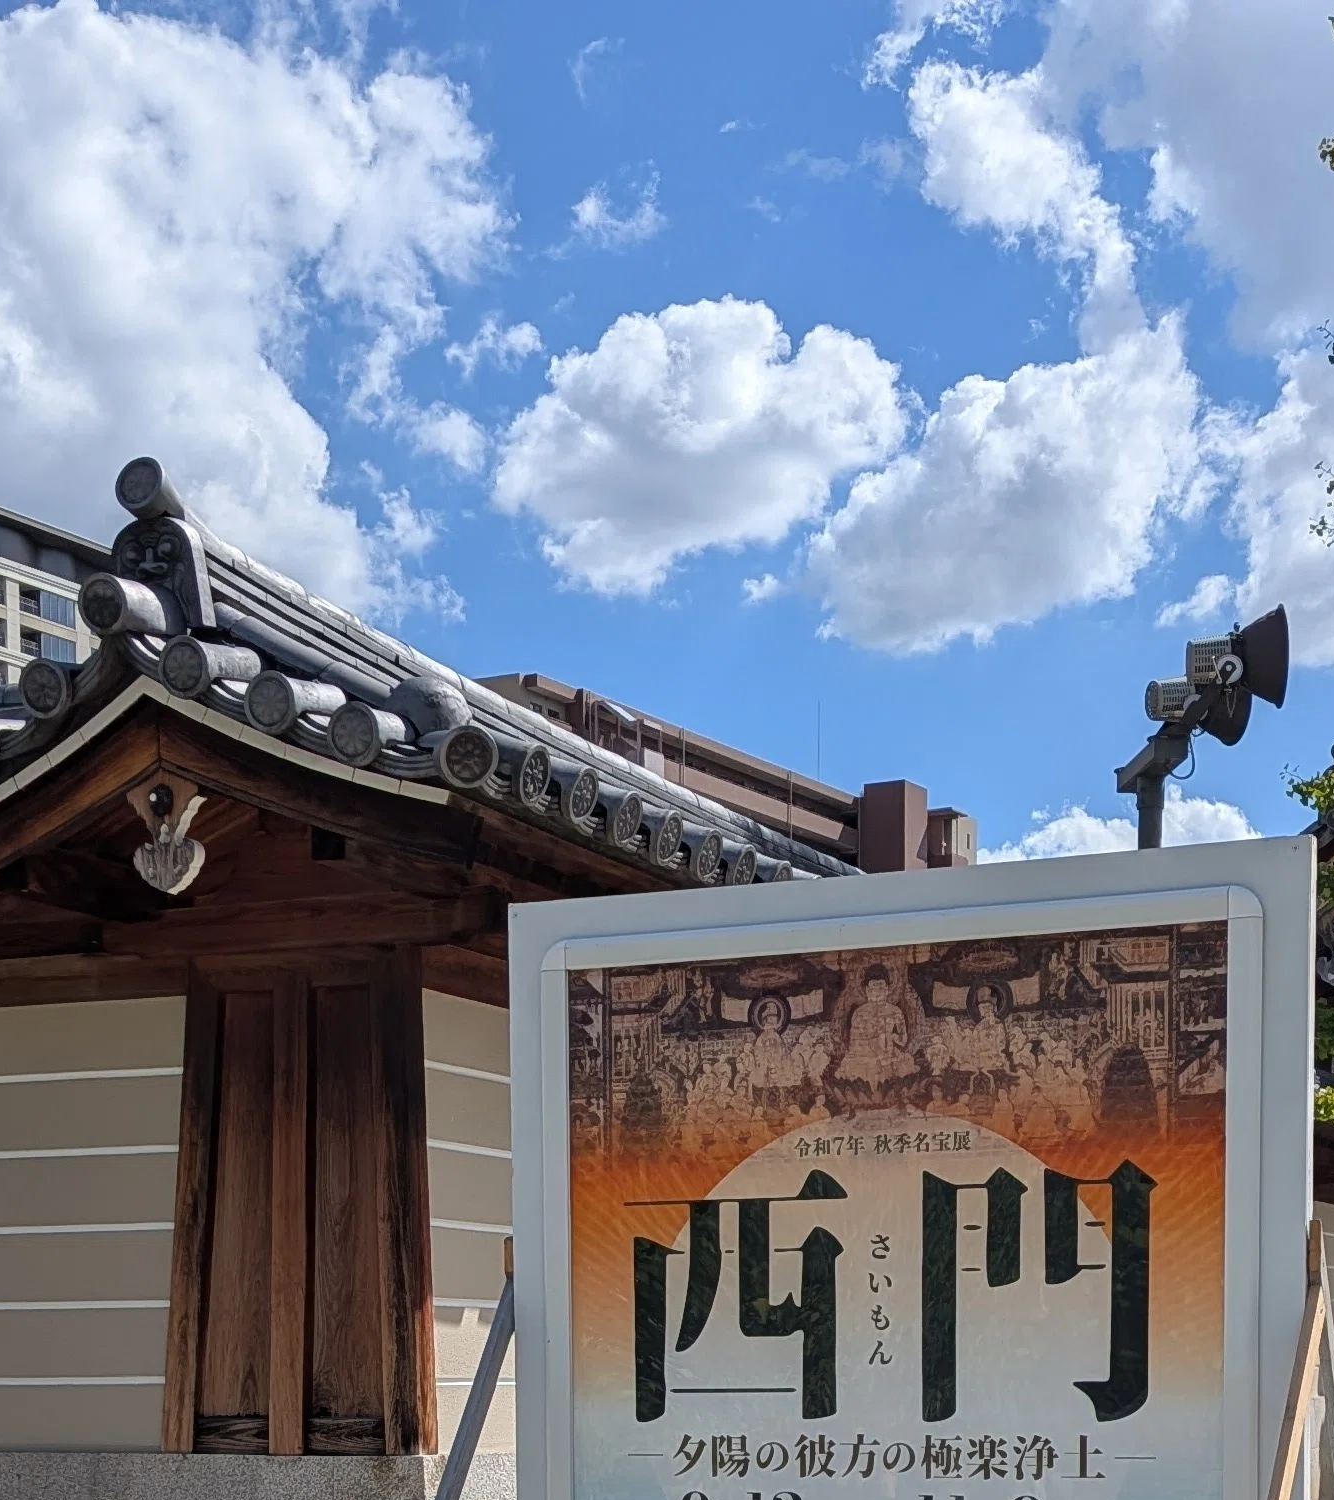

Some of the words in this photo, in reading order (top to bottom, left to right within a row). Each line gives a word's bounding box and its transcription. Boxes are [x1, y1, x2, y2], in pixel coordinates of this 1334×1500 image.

[793, 1135, 865, 1158] 令和7年
[873, 1130, 972, 1155] 秋季名宝展
[623, 1158, 1159, 1424] 西門
[868, 1233, 894, 1367] さいもん
